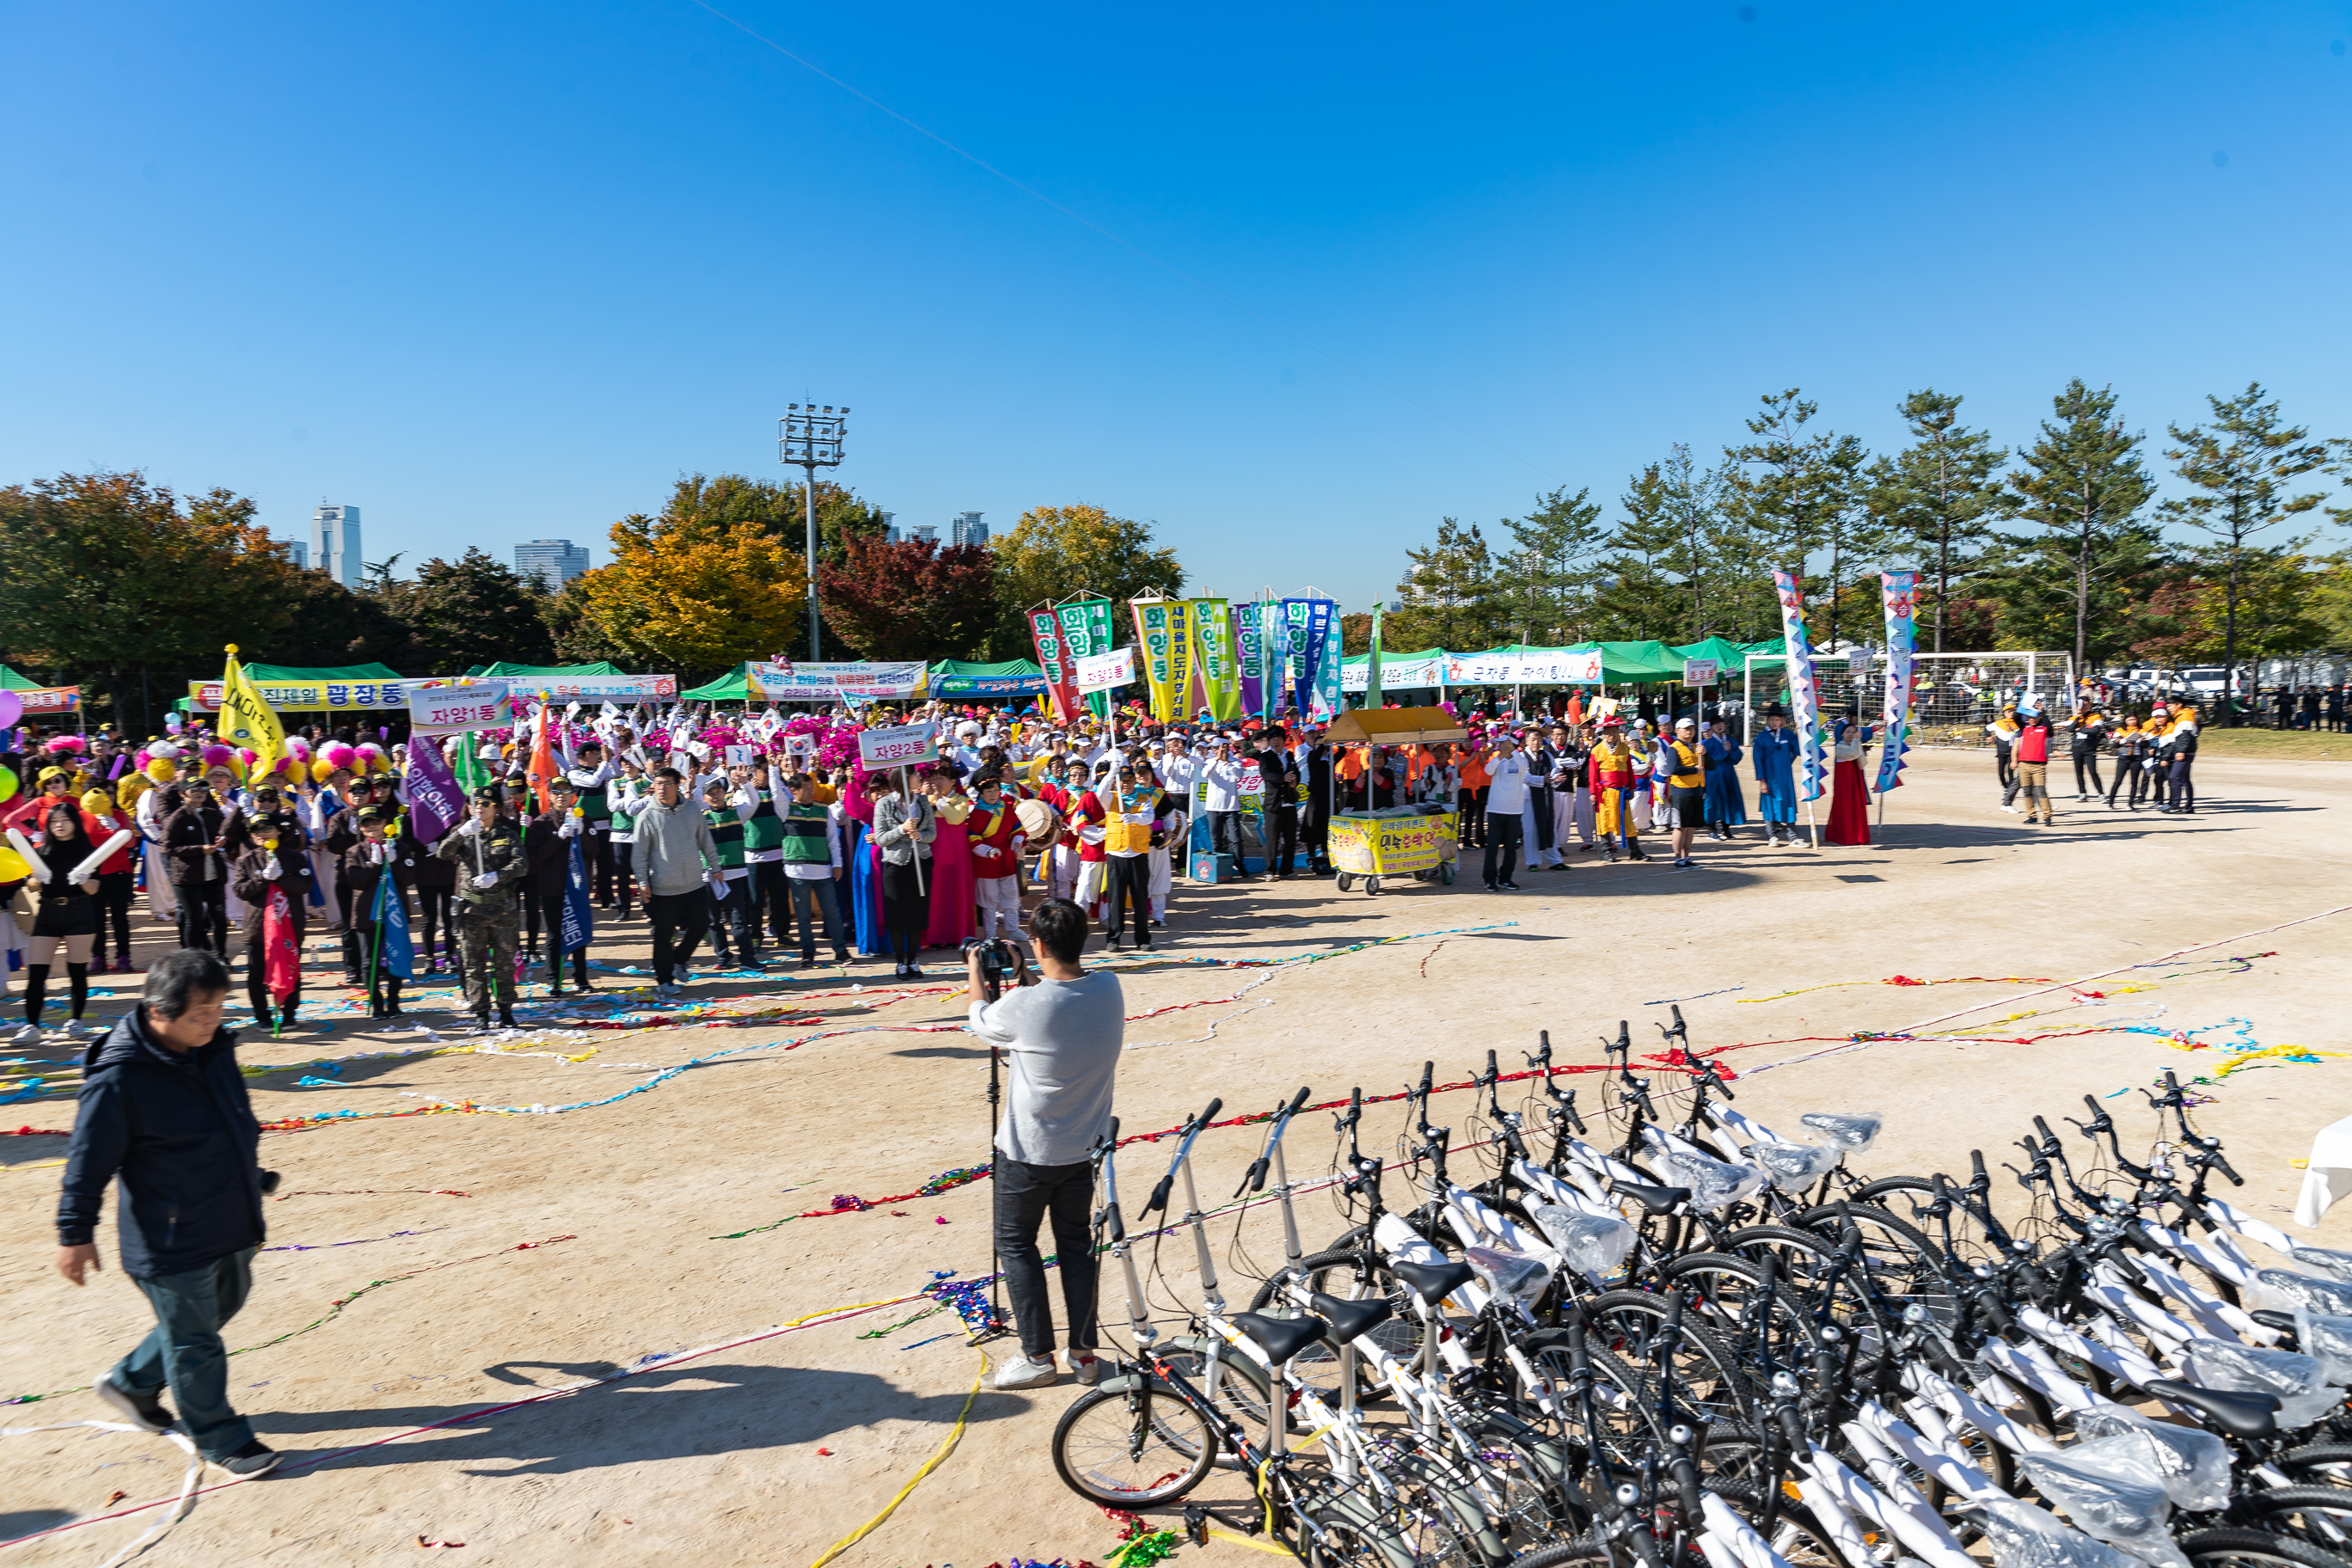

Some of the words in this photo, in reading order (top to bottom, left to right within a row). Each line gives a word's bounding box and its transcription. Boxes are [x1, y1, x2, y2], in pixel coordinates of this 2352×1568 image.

[1033, 614, 1063, 684] 화양동
[1063, 606, 1092, 658] 화양
[1146, 606, 1168, 683] 화양동
[1171, 605, 1186, 717] 새마을지도자협의회
[1197, 603, 1221, 679] 화양동
[1240, 608, 1261, 678] 화양동
[1289, 603, 1308, 678] 화양동
[260, 687, 320, 705] 진제일
[326, 683, 403, 706] 광장동
[1087, 665, 1124, 683] 자양3동
[431, 704, 496, 724] 자양1동
[874, 740, 926, 759] 자양2동
